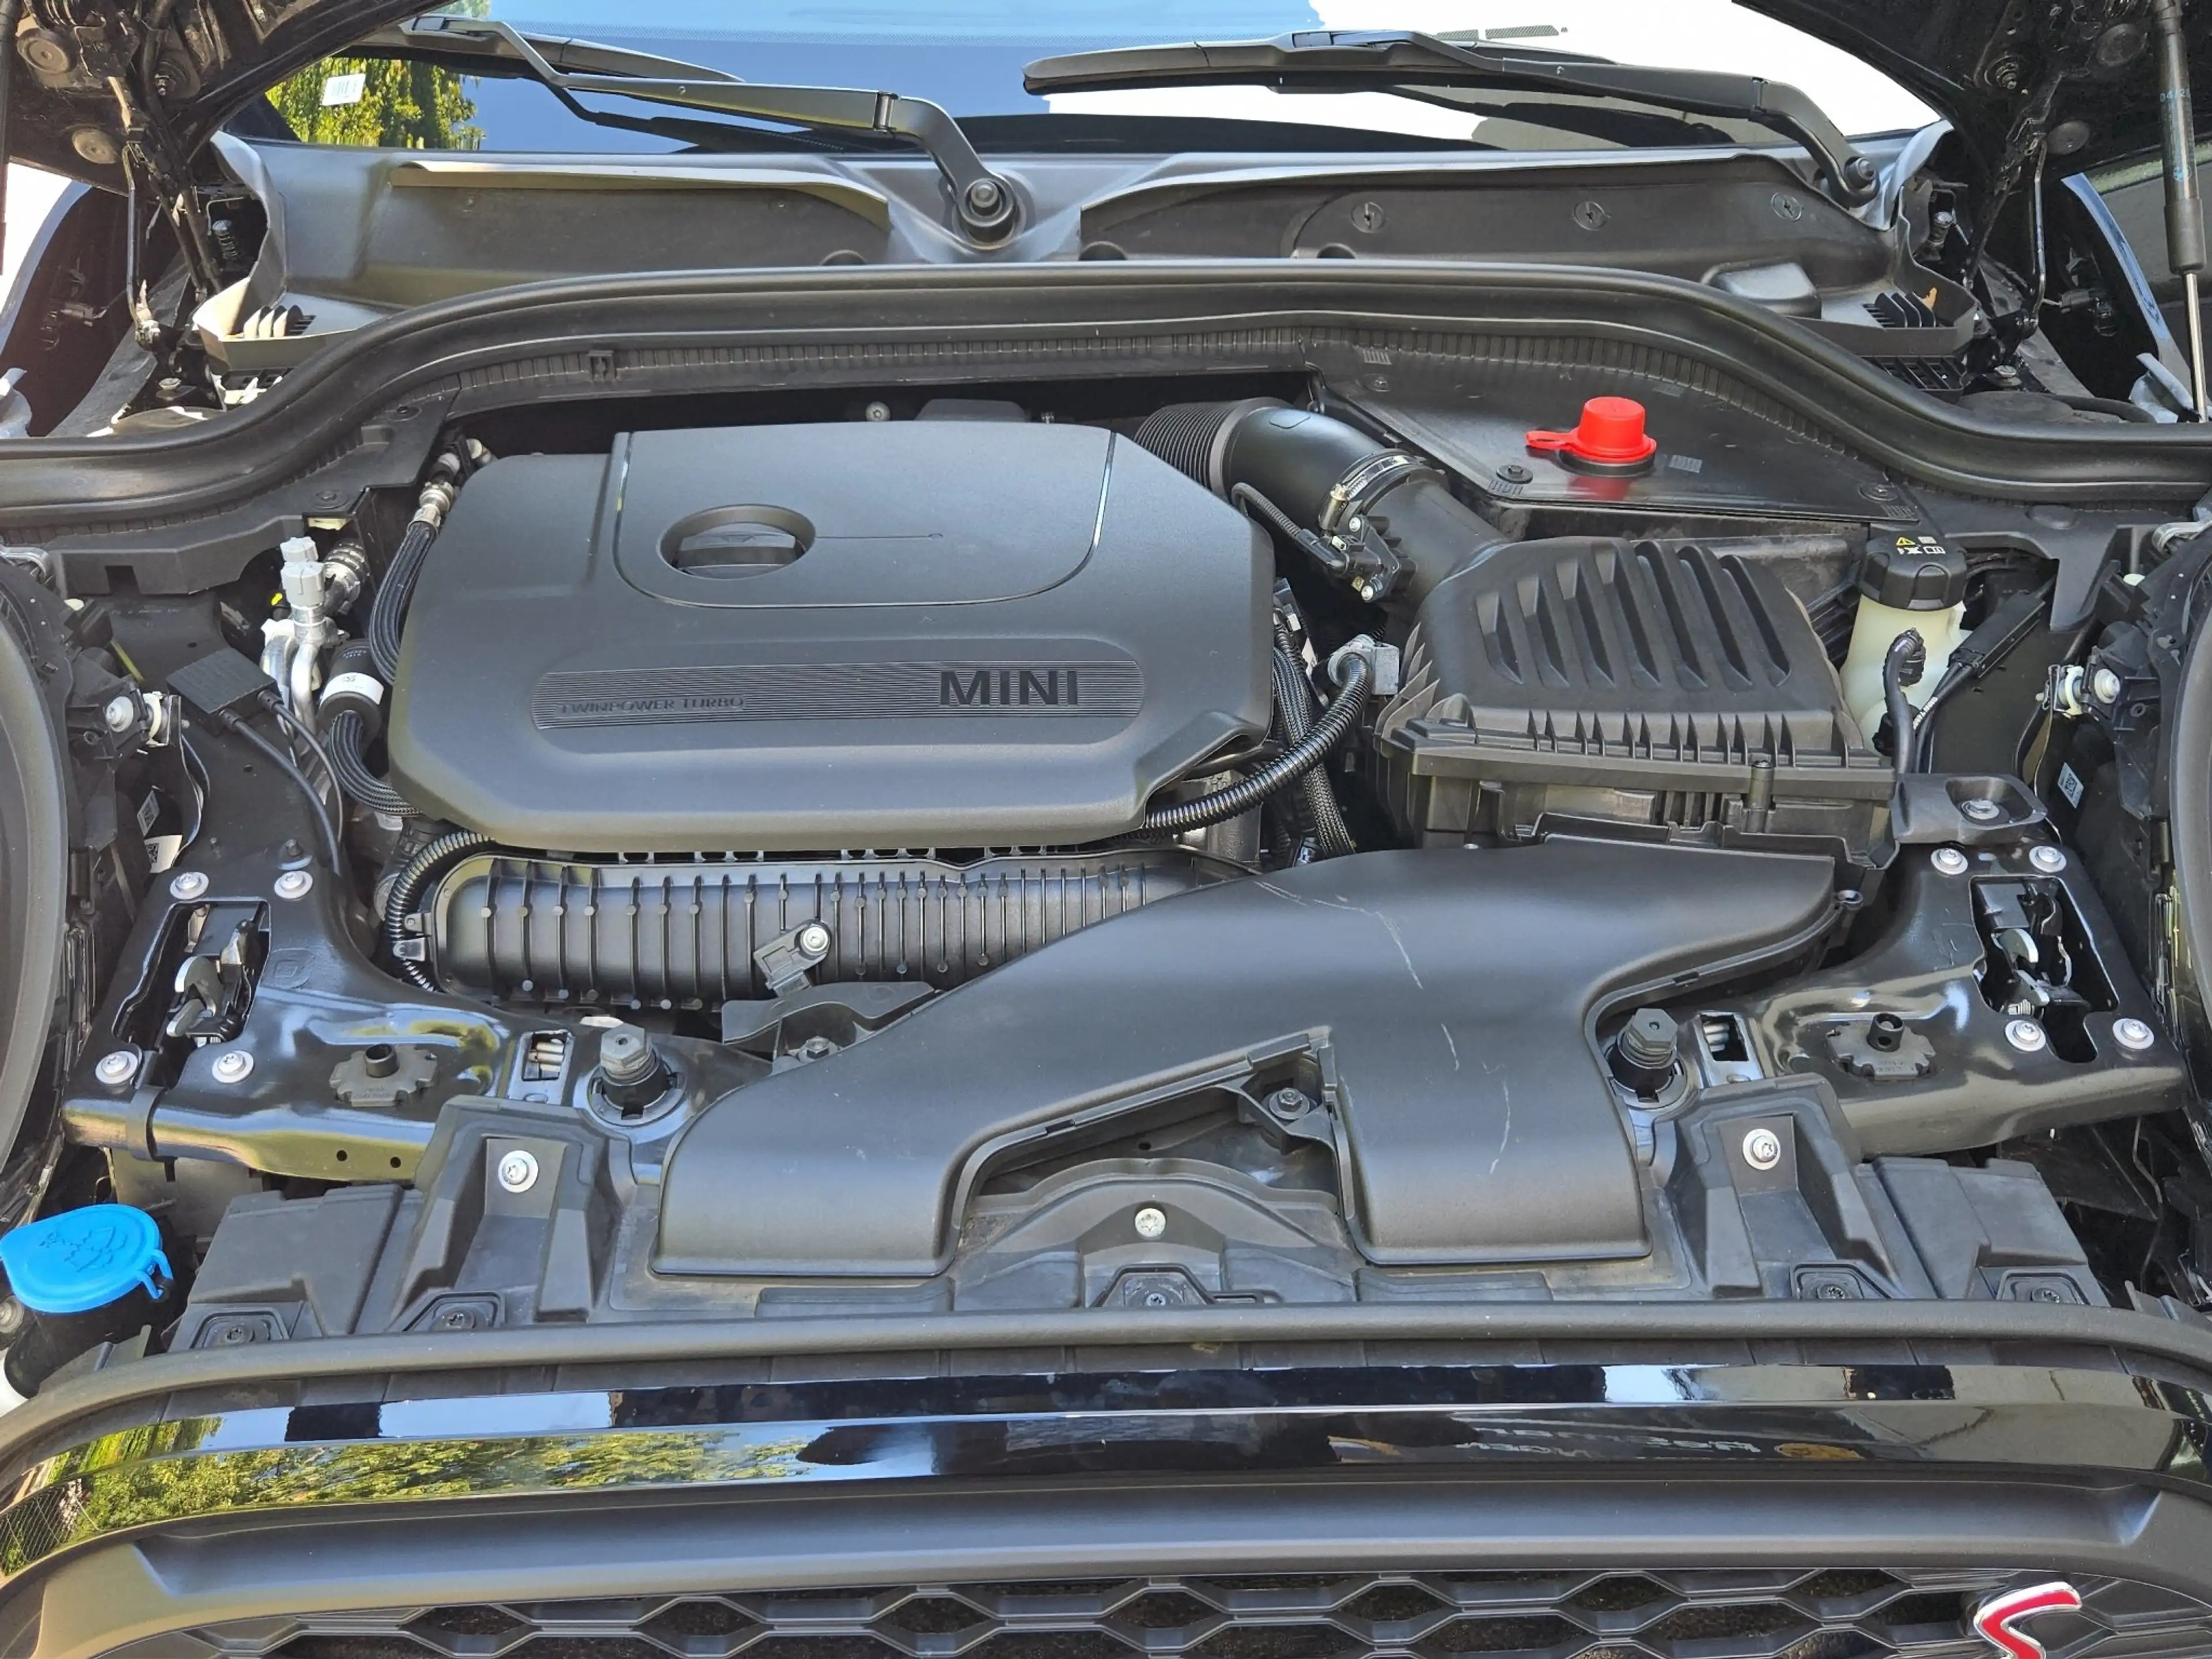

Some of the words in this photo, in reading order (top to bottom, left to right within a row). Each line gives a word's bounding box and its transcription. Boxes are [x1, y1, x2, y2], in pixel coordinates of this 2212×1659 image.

[940, 671, 1078, 706] MINI
[561, 698, 675, 714] TWINPOWER
[683, 696, 744, 709] TURBO
